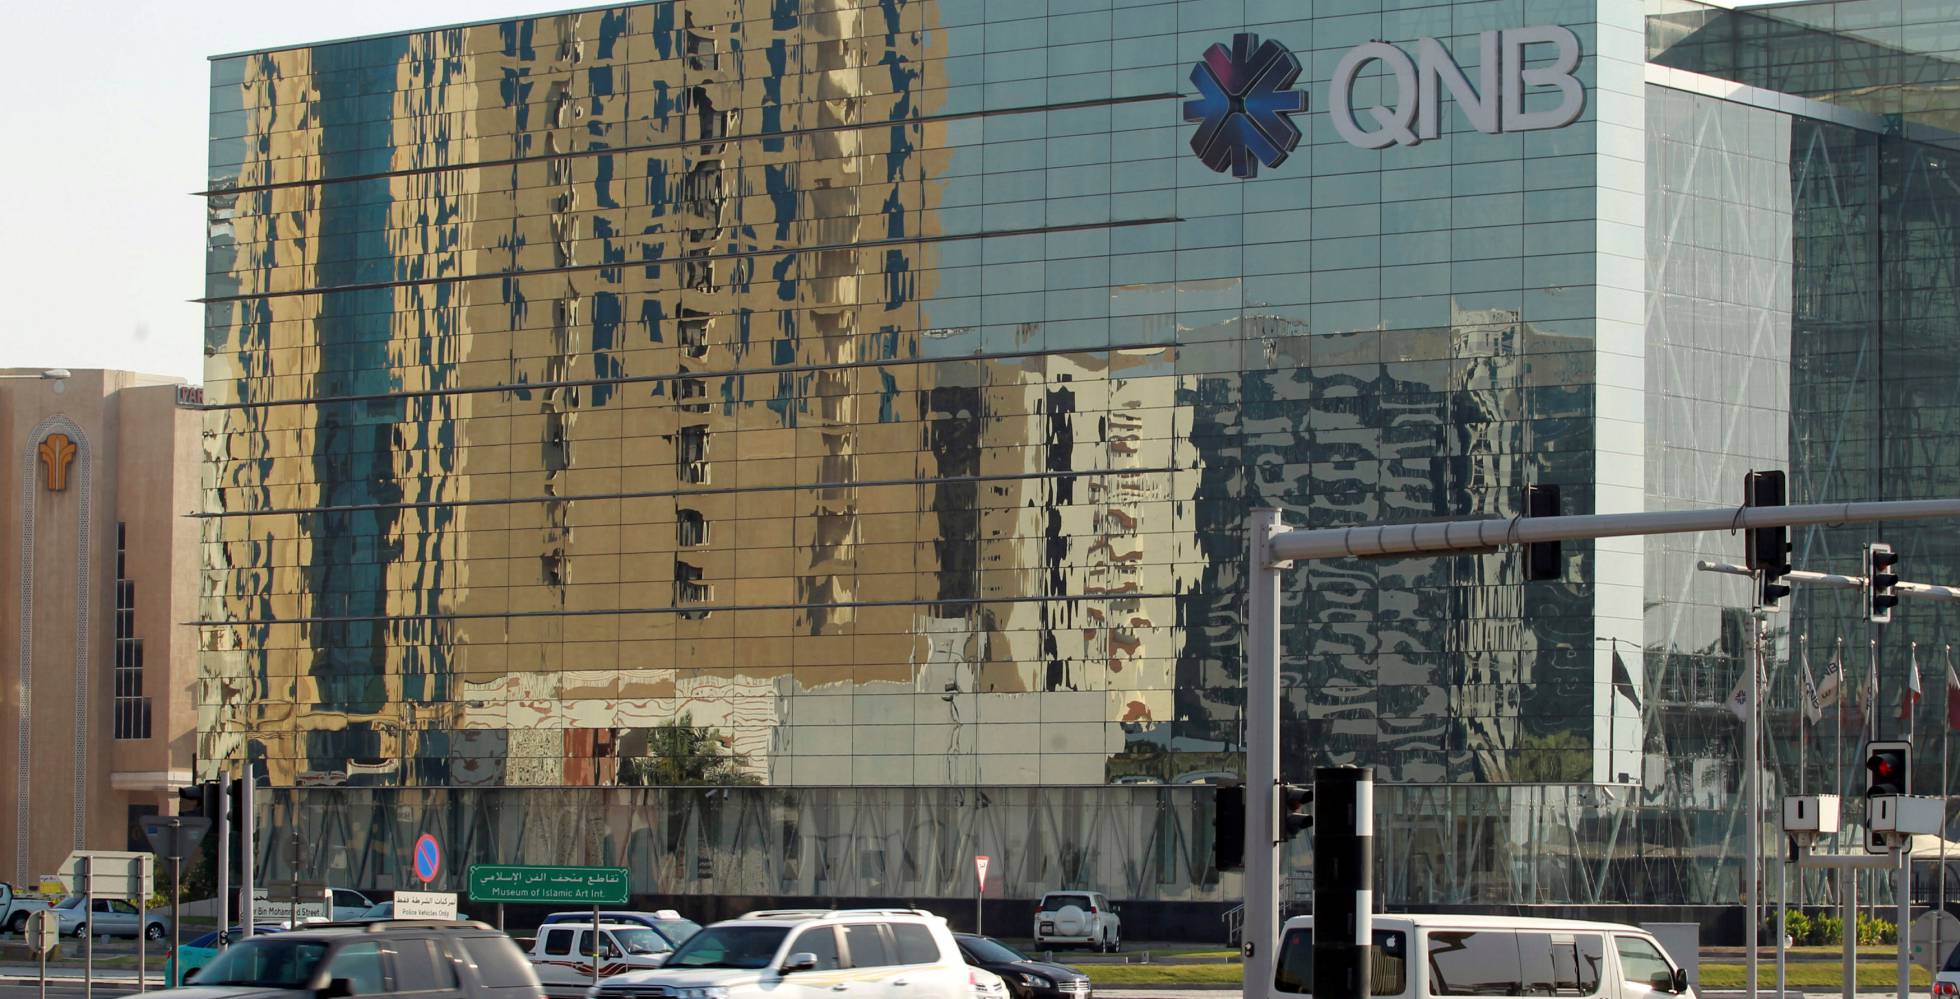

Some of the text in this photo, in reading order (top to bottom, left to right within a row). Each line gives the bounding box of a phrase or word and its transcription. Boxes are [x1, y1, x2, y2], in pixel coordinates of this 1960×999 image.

[1329, 25, 1586, 149] QNB
[525, 872, 547, 884] الفن
[551, 873, 583, 882] متحف
[588, 873, 619, 886] تقاطع
[492, 887, 529, 896] Museum
[530, 888, 540, 897] of
[542, 888, 573, 897] Islamic
[575, 889, 589, 898] Art
[257, 906, 268, 916] Bin
[302, 907, 320, 917] Street
